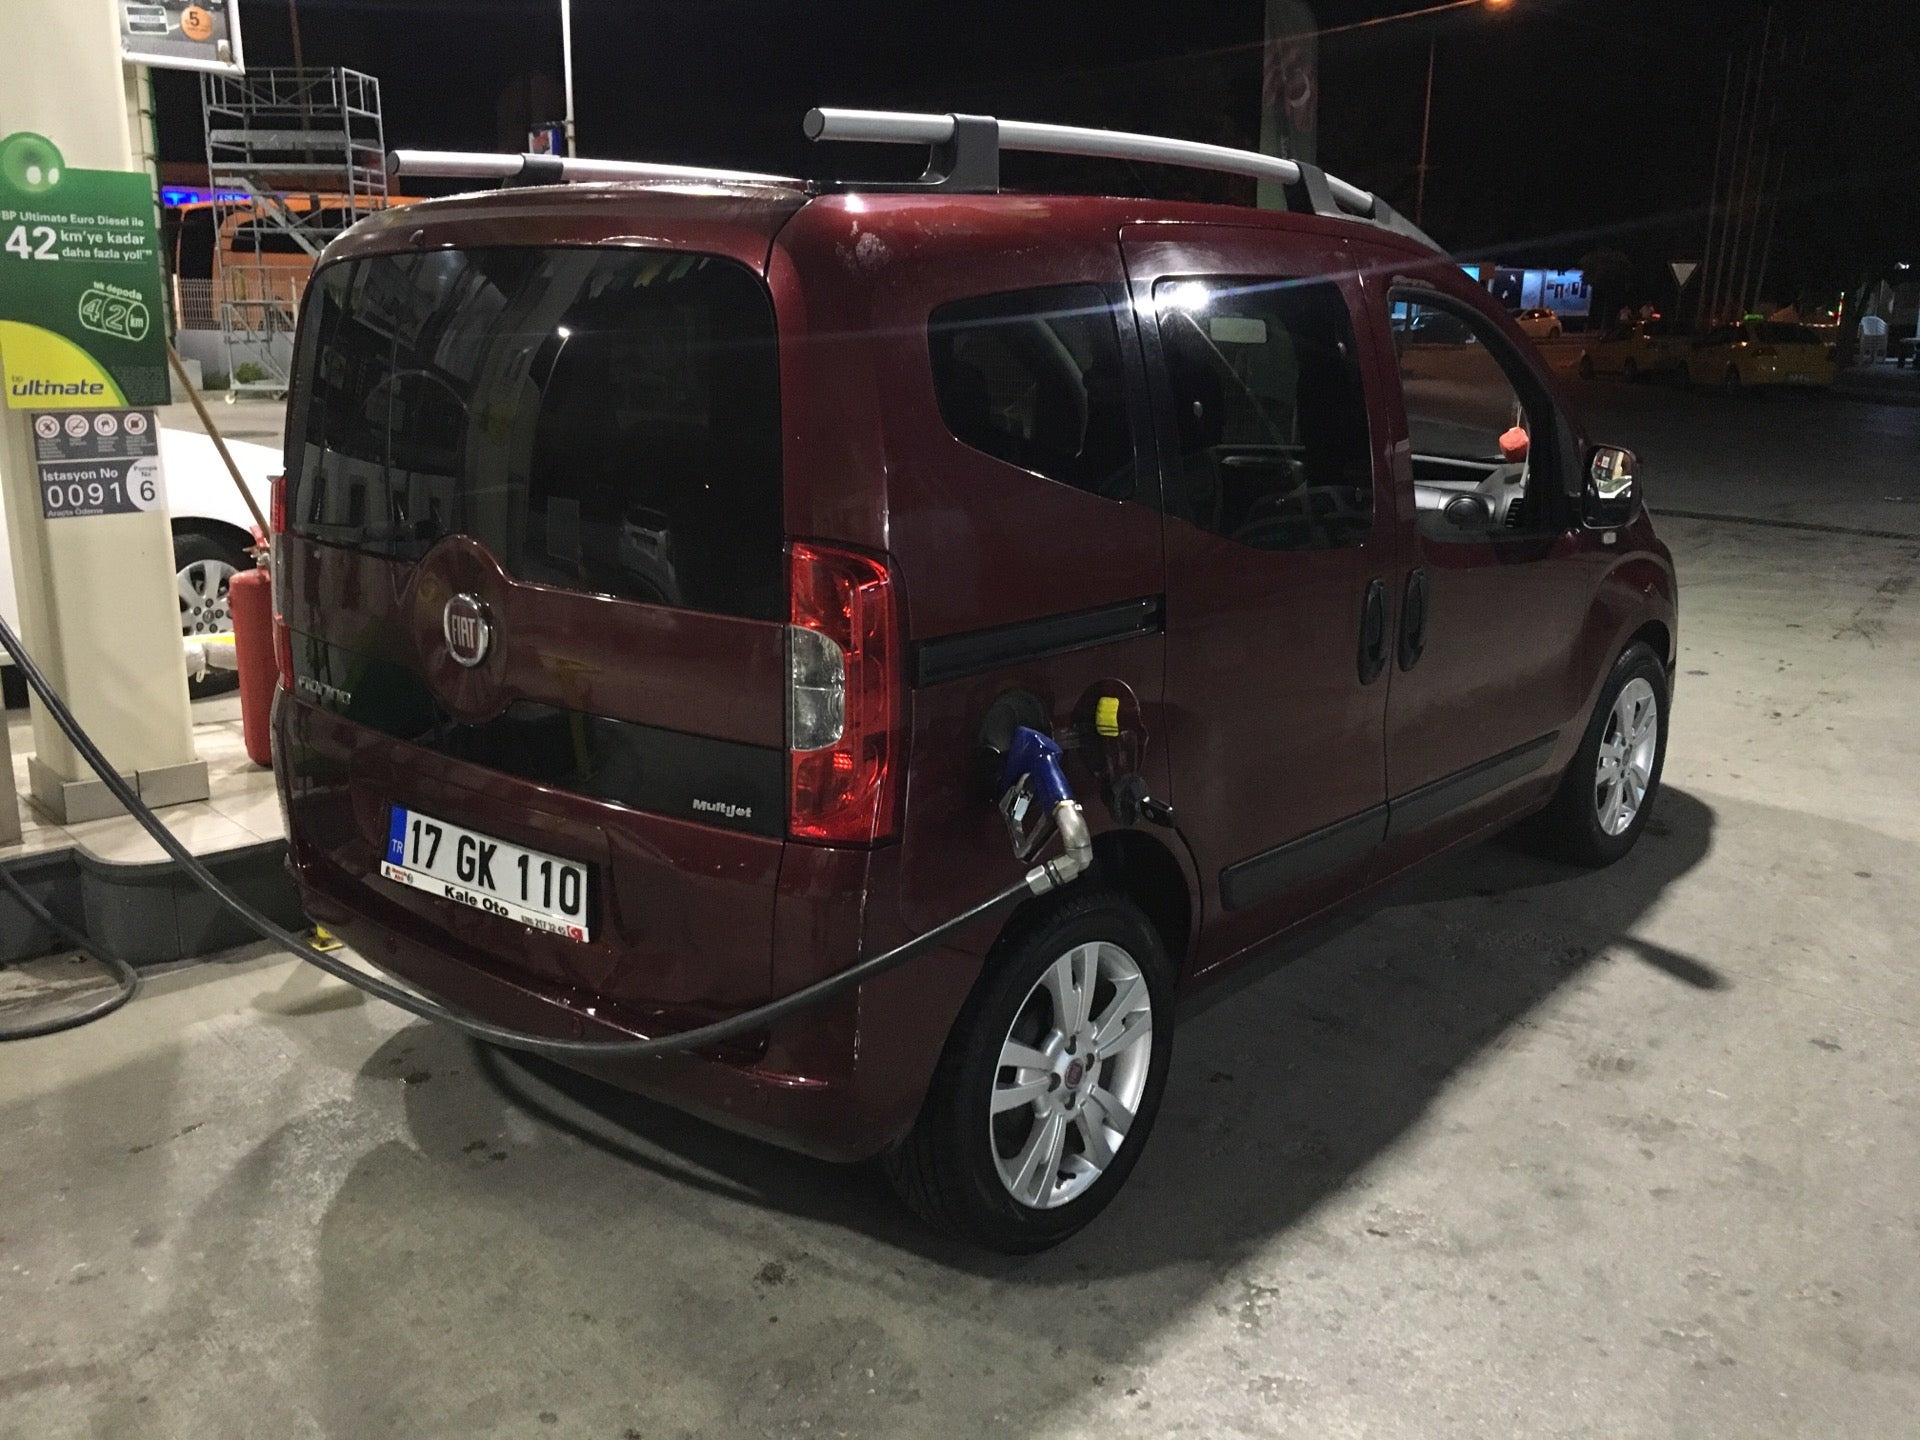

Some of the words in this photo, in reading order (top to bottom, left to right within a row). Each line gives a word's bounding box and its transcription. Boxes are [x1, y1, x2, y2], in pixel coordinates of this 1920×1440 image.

[19, 211, 67, 223] Ultimate
[70, 214, 95, 224] Euro
[97, 215, 129, 227] Diesel
[132, 217, 144, 227] ile
[5, 225, 59, 260] 42
[60, 230, 103, 245] km'ye
[107, 231, 145, 245] kadar
[62, 247, 91, 258] daha
[94, 248, 120, 259] fazla
[106, 284, 142, 300] depoda
[12, 379, 104, 396] ultimate
[100, 467, 118, 479] No
[47, 482, 121, 508] 0091
[140, 480, 156, 502] 6
[451, 614, 476, 649] FIAT
[391, 839, 404, 855] TR
[412, 820, 442, 869] 17
[456, 835, 498, 890] GK
[517, 854, 581, 916] 110
[445, 885, 478, 906] Kale
[482, 899, 509, 916] Oto
